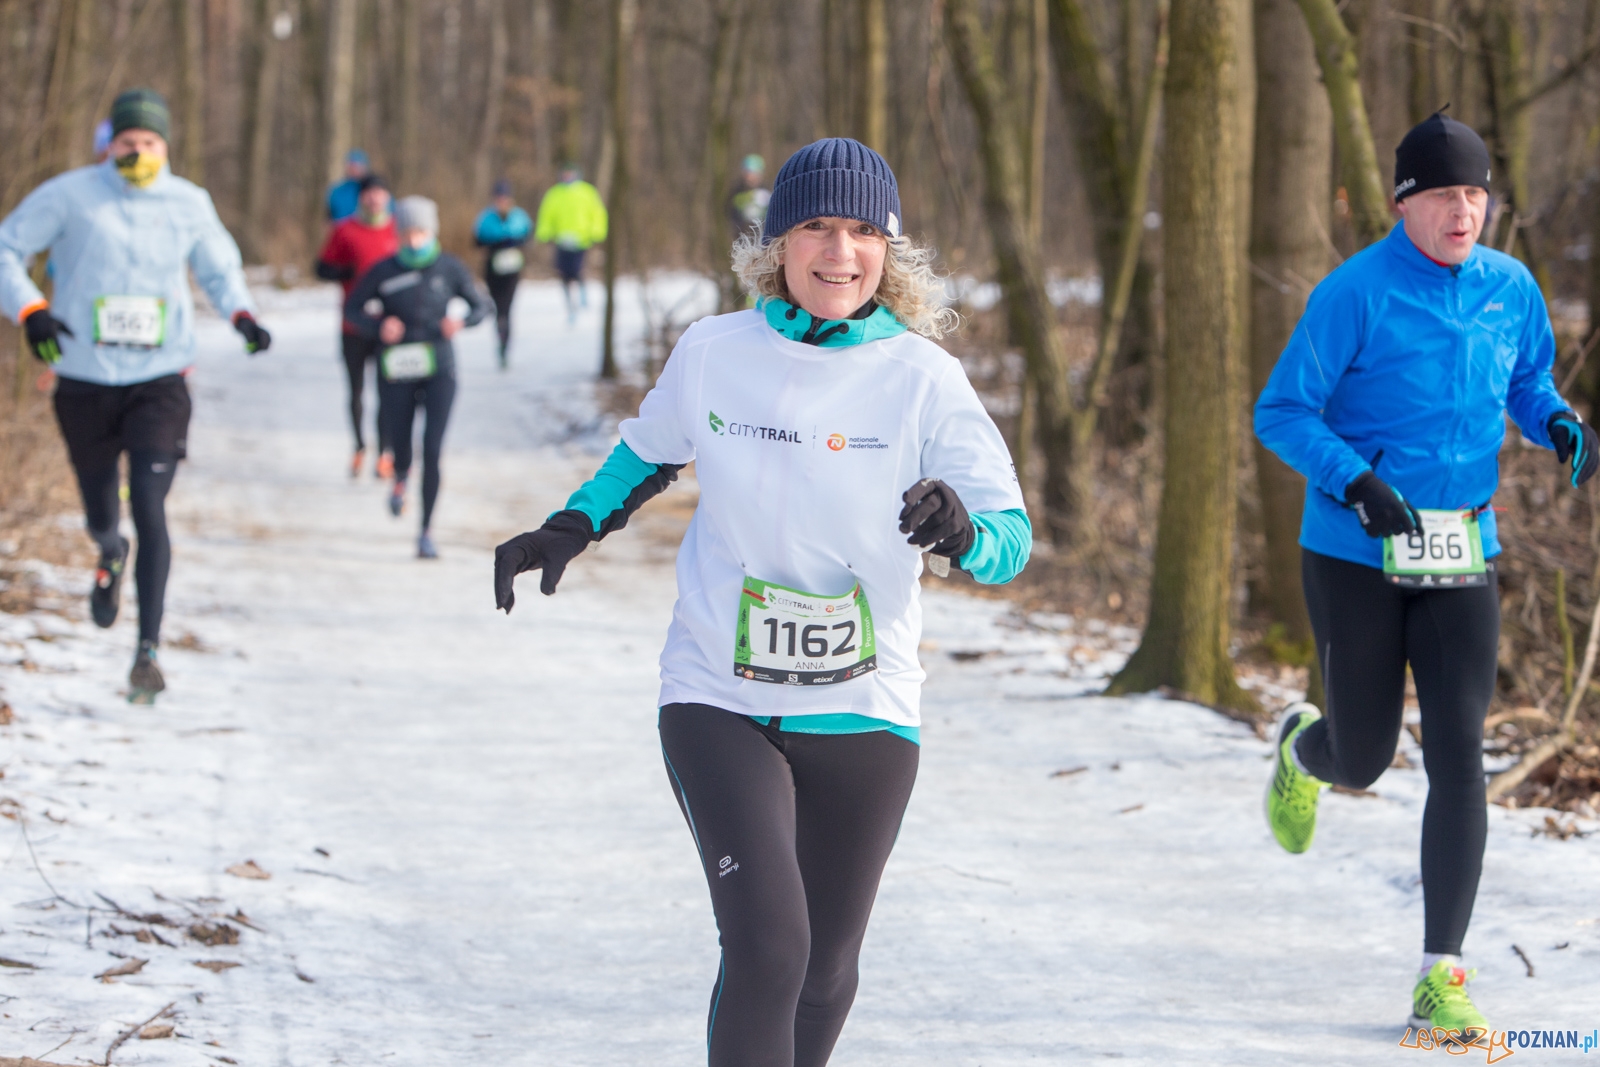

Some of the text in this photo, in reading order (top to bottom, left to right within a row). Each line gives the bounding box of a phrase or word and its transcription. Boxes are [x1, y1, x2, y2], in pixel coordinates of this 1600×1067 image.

[1407, 532, 1462, 560] 966
[763, 617, 856, 658] 1162
[794, 661, 826, 670] ANNA
